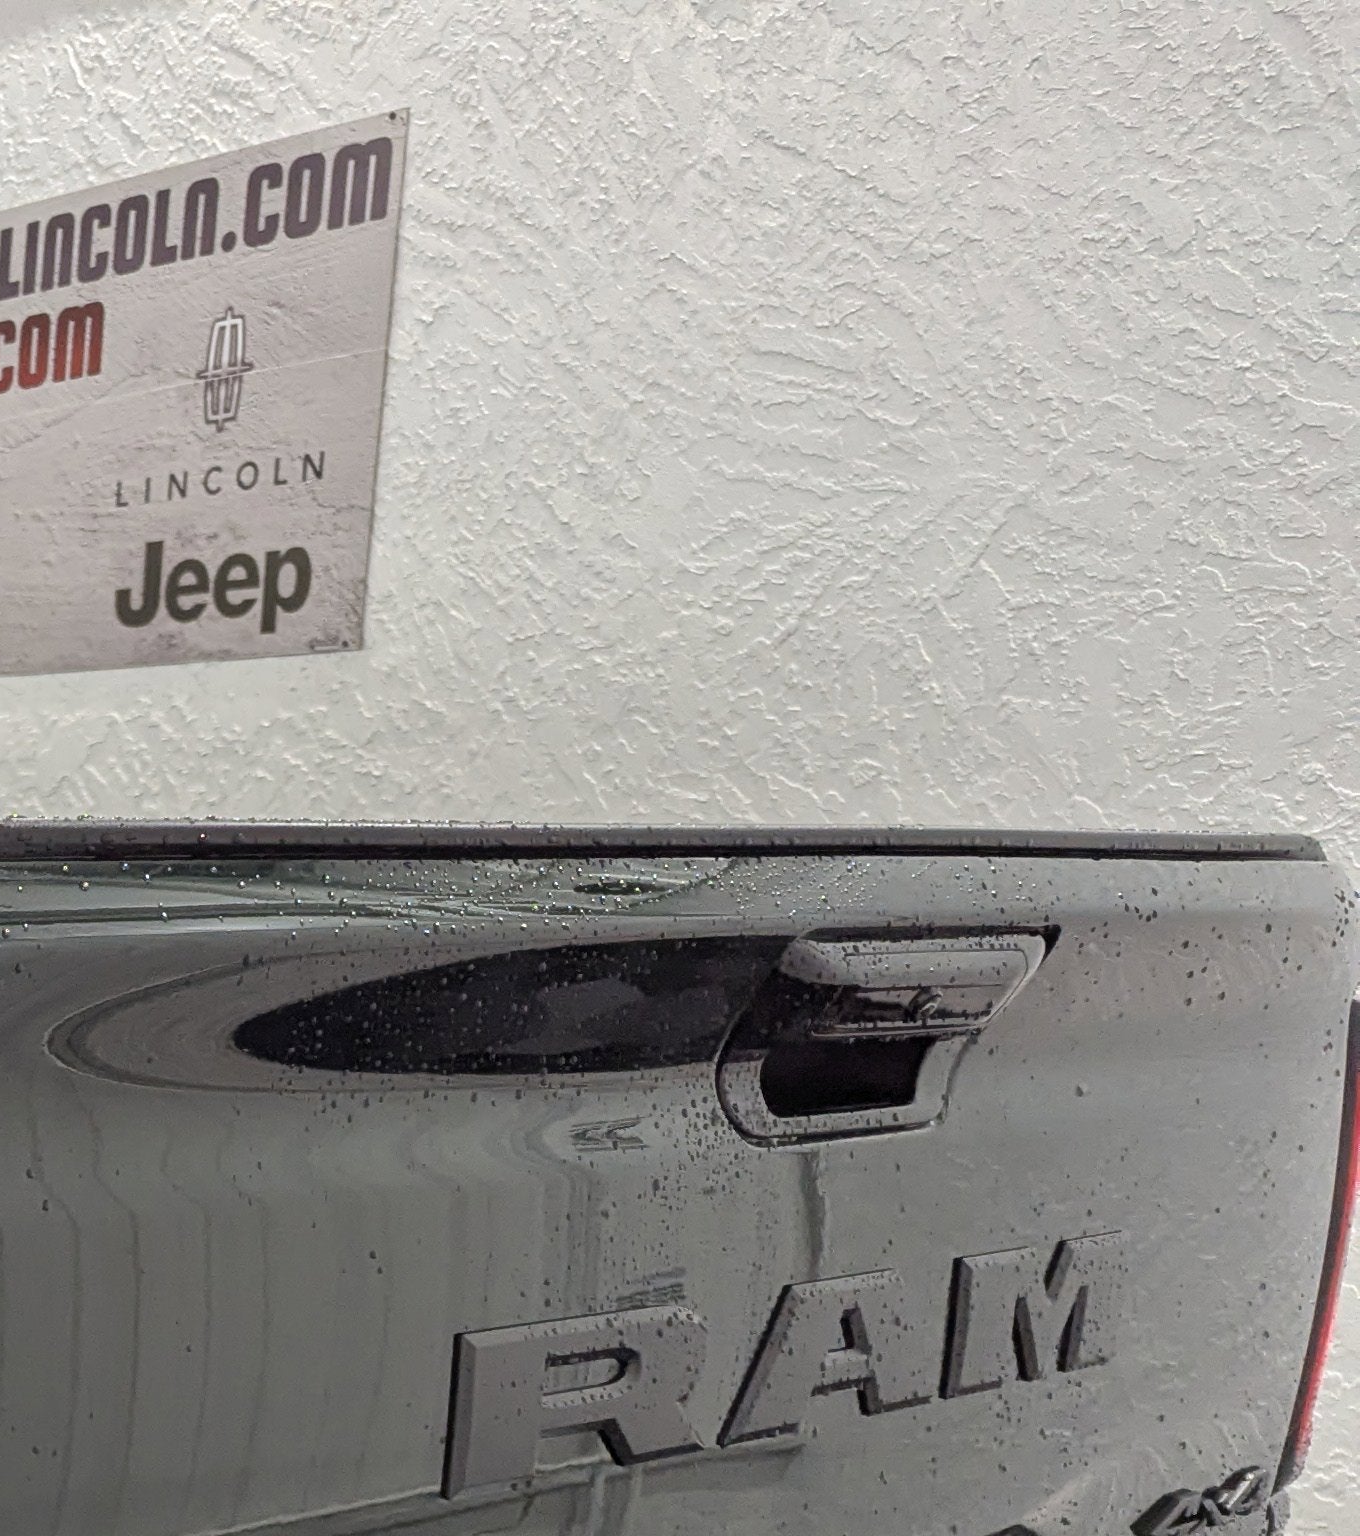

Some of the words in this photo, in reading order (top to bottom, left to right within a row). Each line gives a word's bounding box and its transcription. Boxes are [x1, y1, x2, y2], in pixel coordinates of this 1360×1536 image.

[115, 450, 325, 507] LINCOLN
[115, 540, 312, 634] Jeep
[440, 1229, 1125, 1498] RAM
